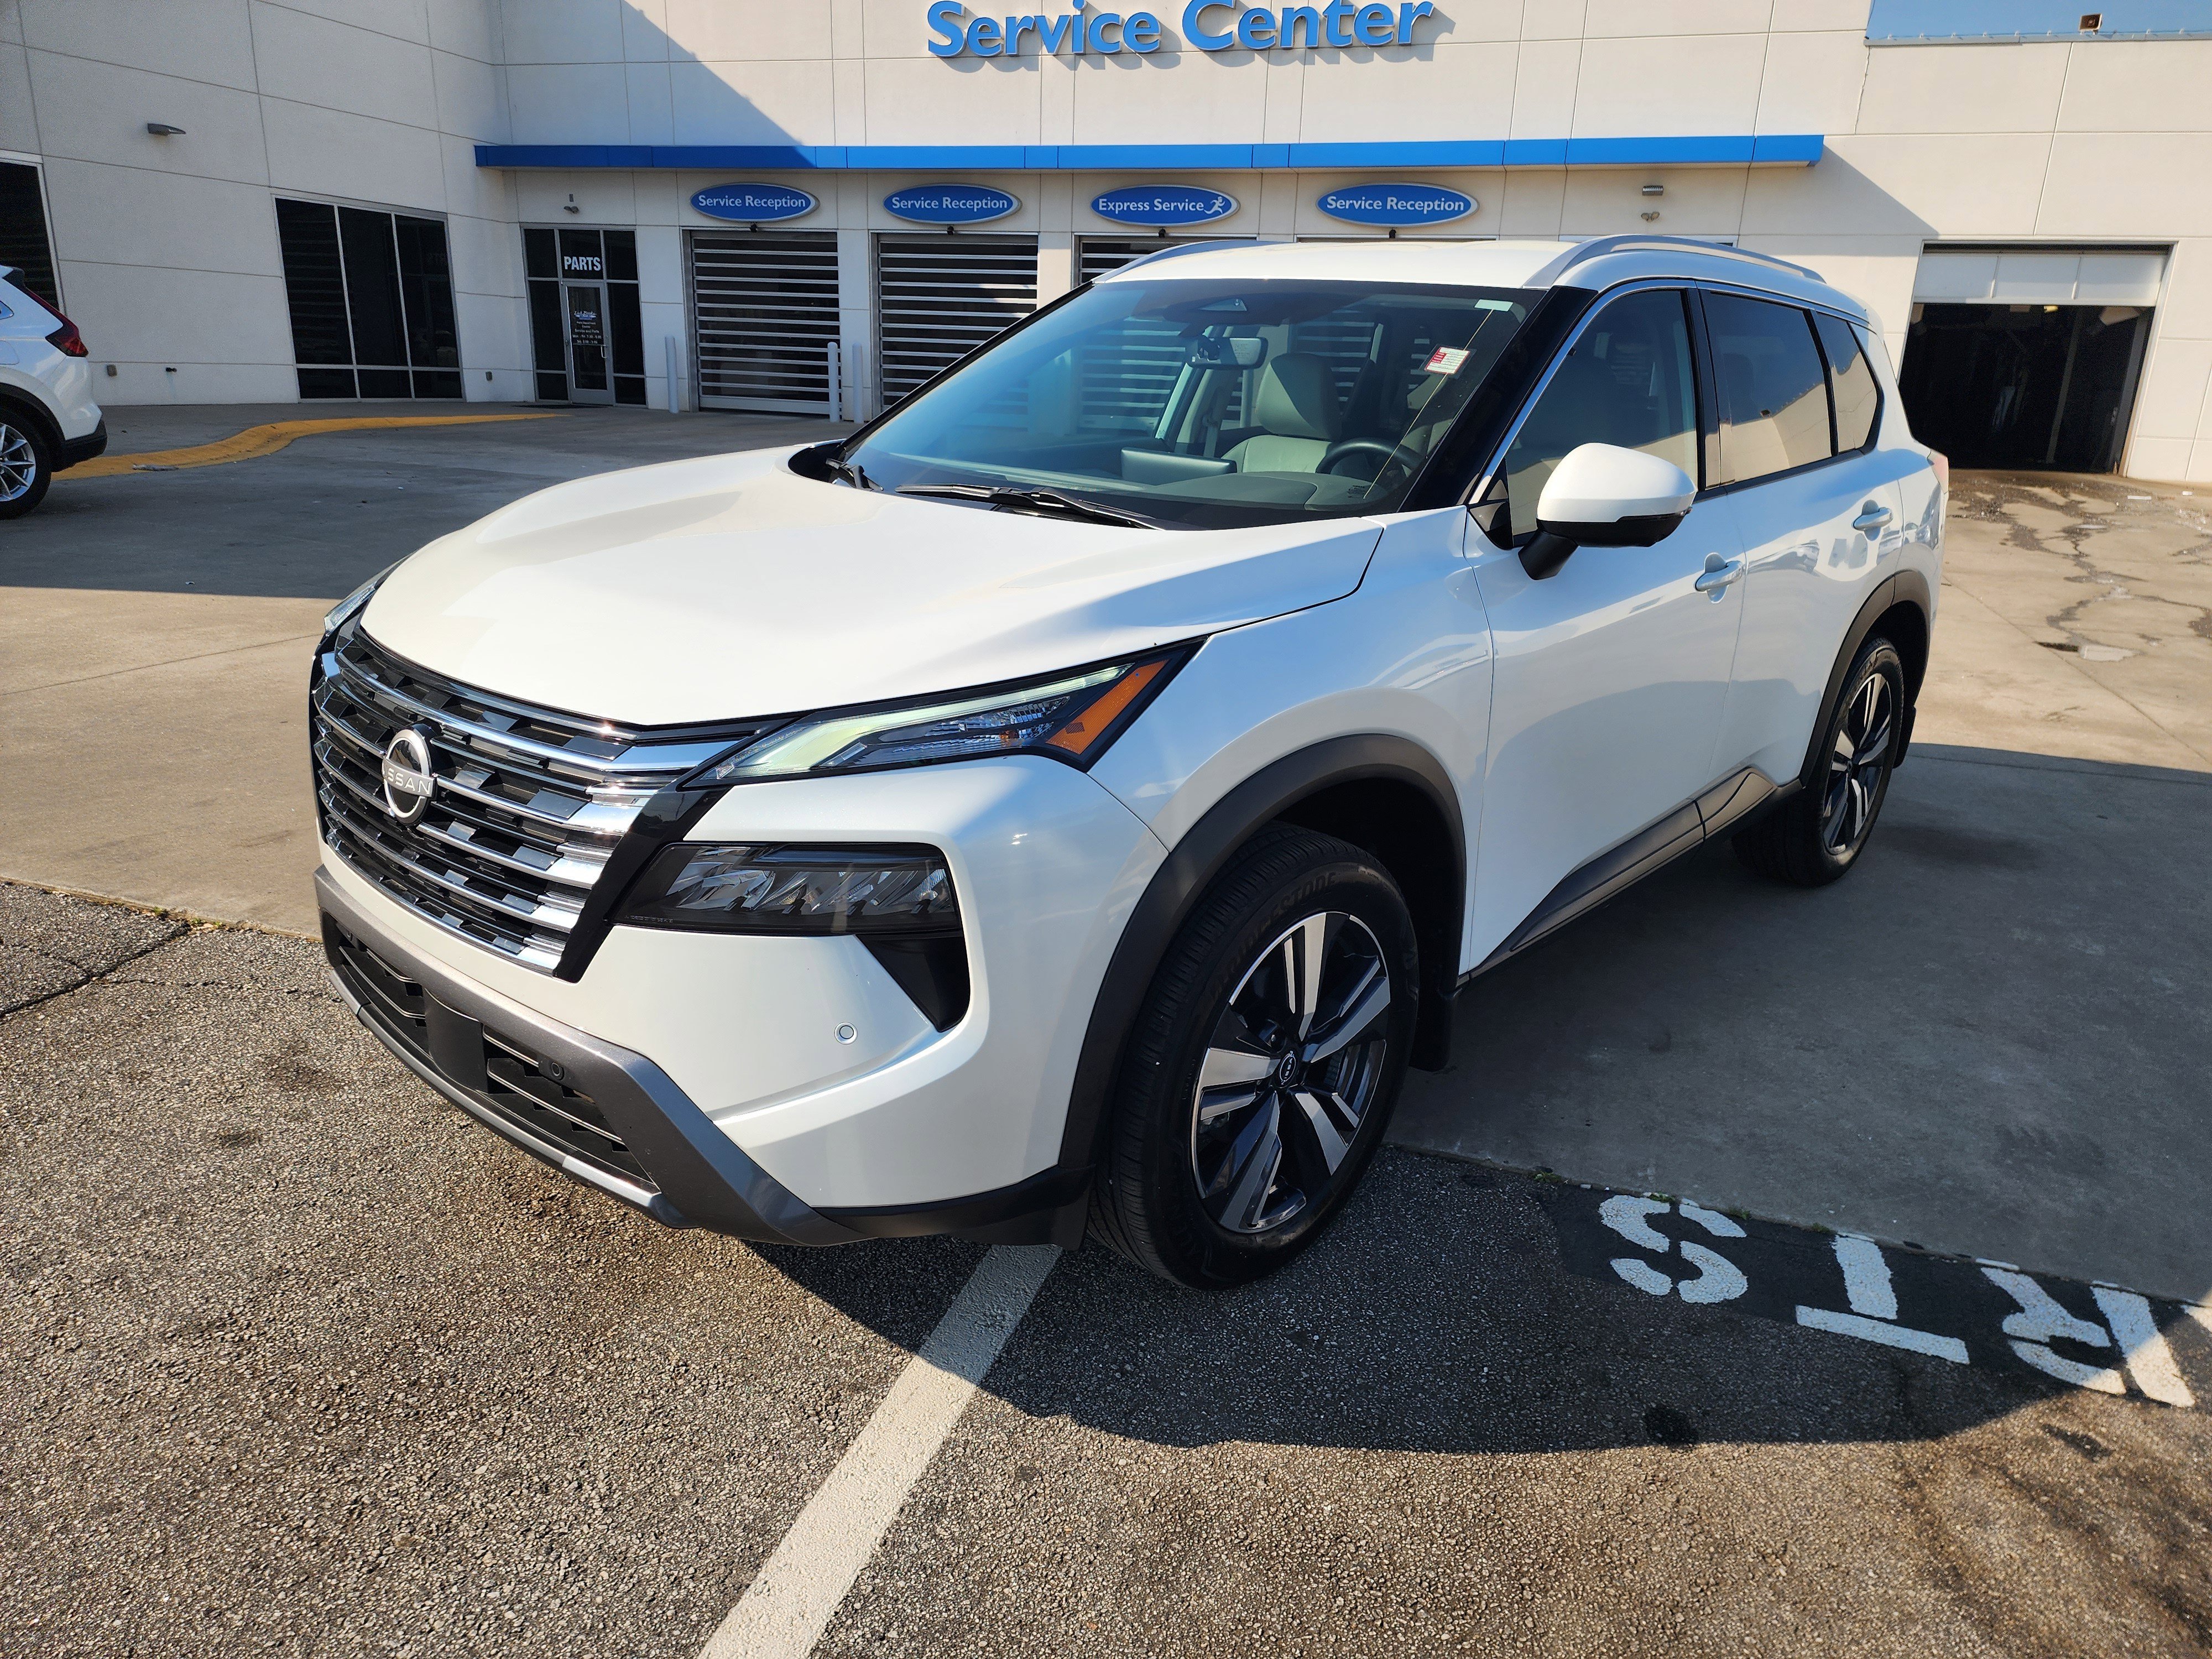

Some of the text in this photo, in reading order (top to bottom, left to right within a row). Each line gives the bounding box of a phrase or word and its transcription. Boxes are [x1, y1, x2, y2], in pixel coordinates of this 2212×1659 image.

[927, 0, 1434, 58] Service Center
[698, 195, 806, 211] Service Reception
[891, 196, 1008, 212] Service Reception
[1098, 198, 1204, 214] Express Service
[1326, 195, 1464, 214] Service Reception
[564, 256, 601, 271] PARTS
[387, 767, 431, 795] SSAN
